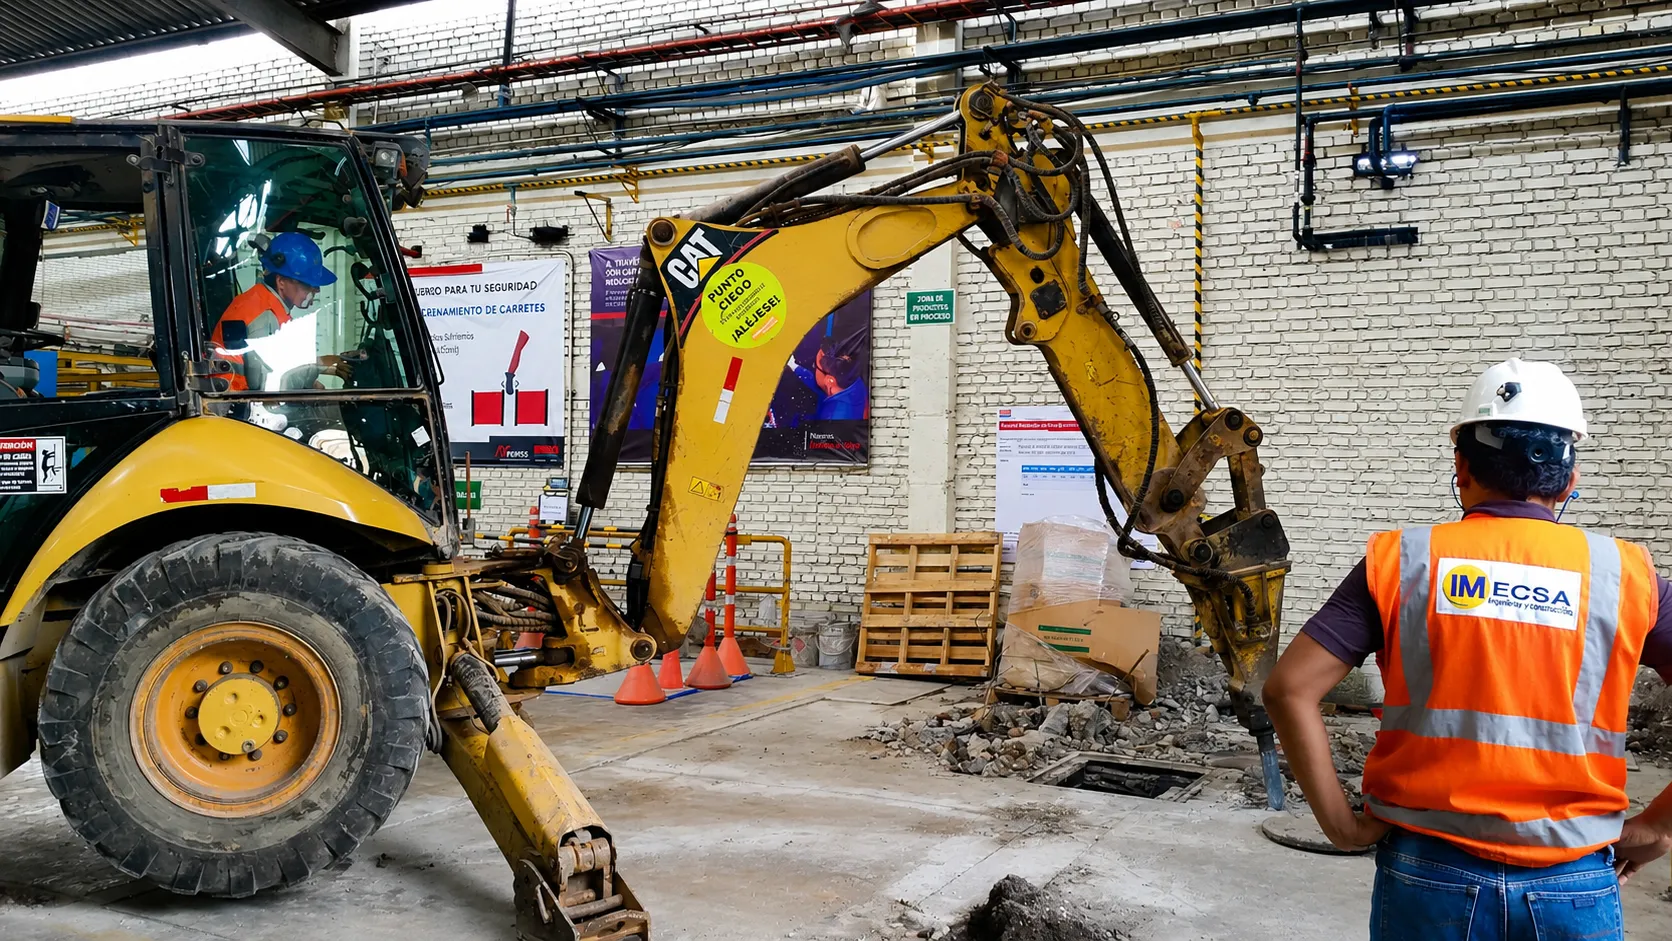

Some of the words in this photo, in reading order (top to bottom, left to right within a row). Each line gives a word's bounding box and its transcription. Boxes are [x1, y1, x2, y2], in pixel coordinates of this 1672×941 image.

[667, 227, 723, 289] CAT
[444, 285, 468, 295] PARA
[470, 284, 481, 294] TU
[484, 280, 538, 293] SEGURIDAD
[707, 268, 745, 303] PUNTO
[485, 305, 497, 315] DE
[499, 302, 546, 315] CARRETES
